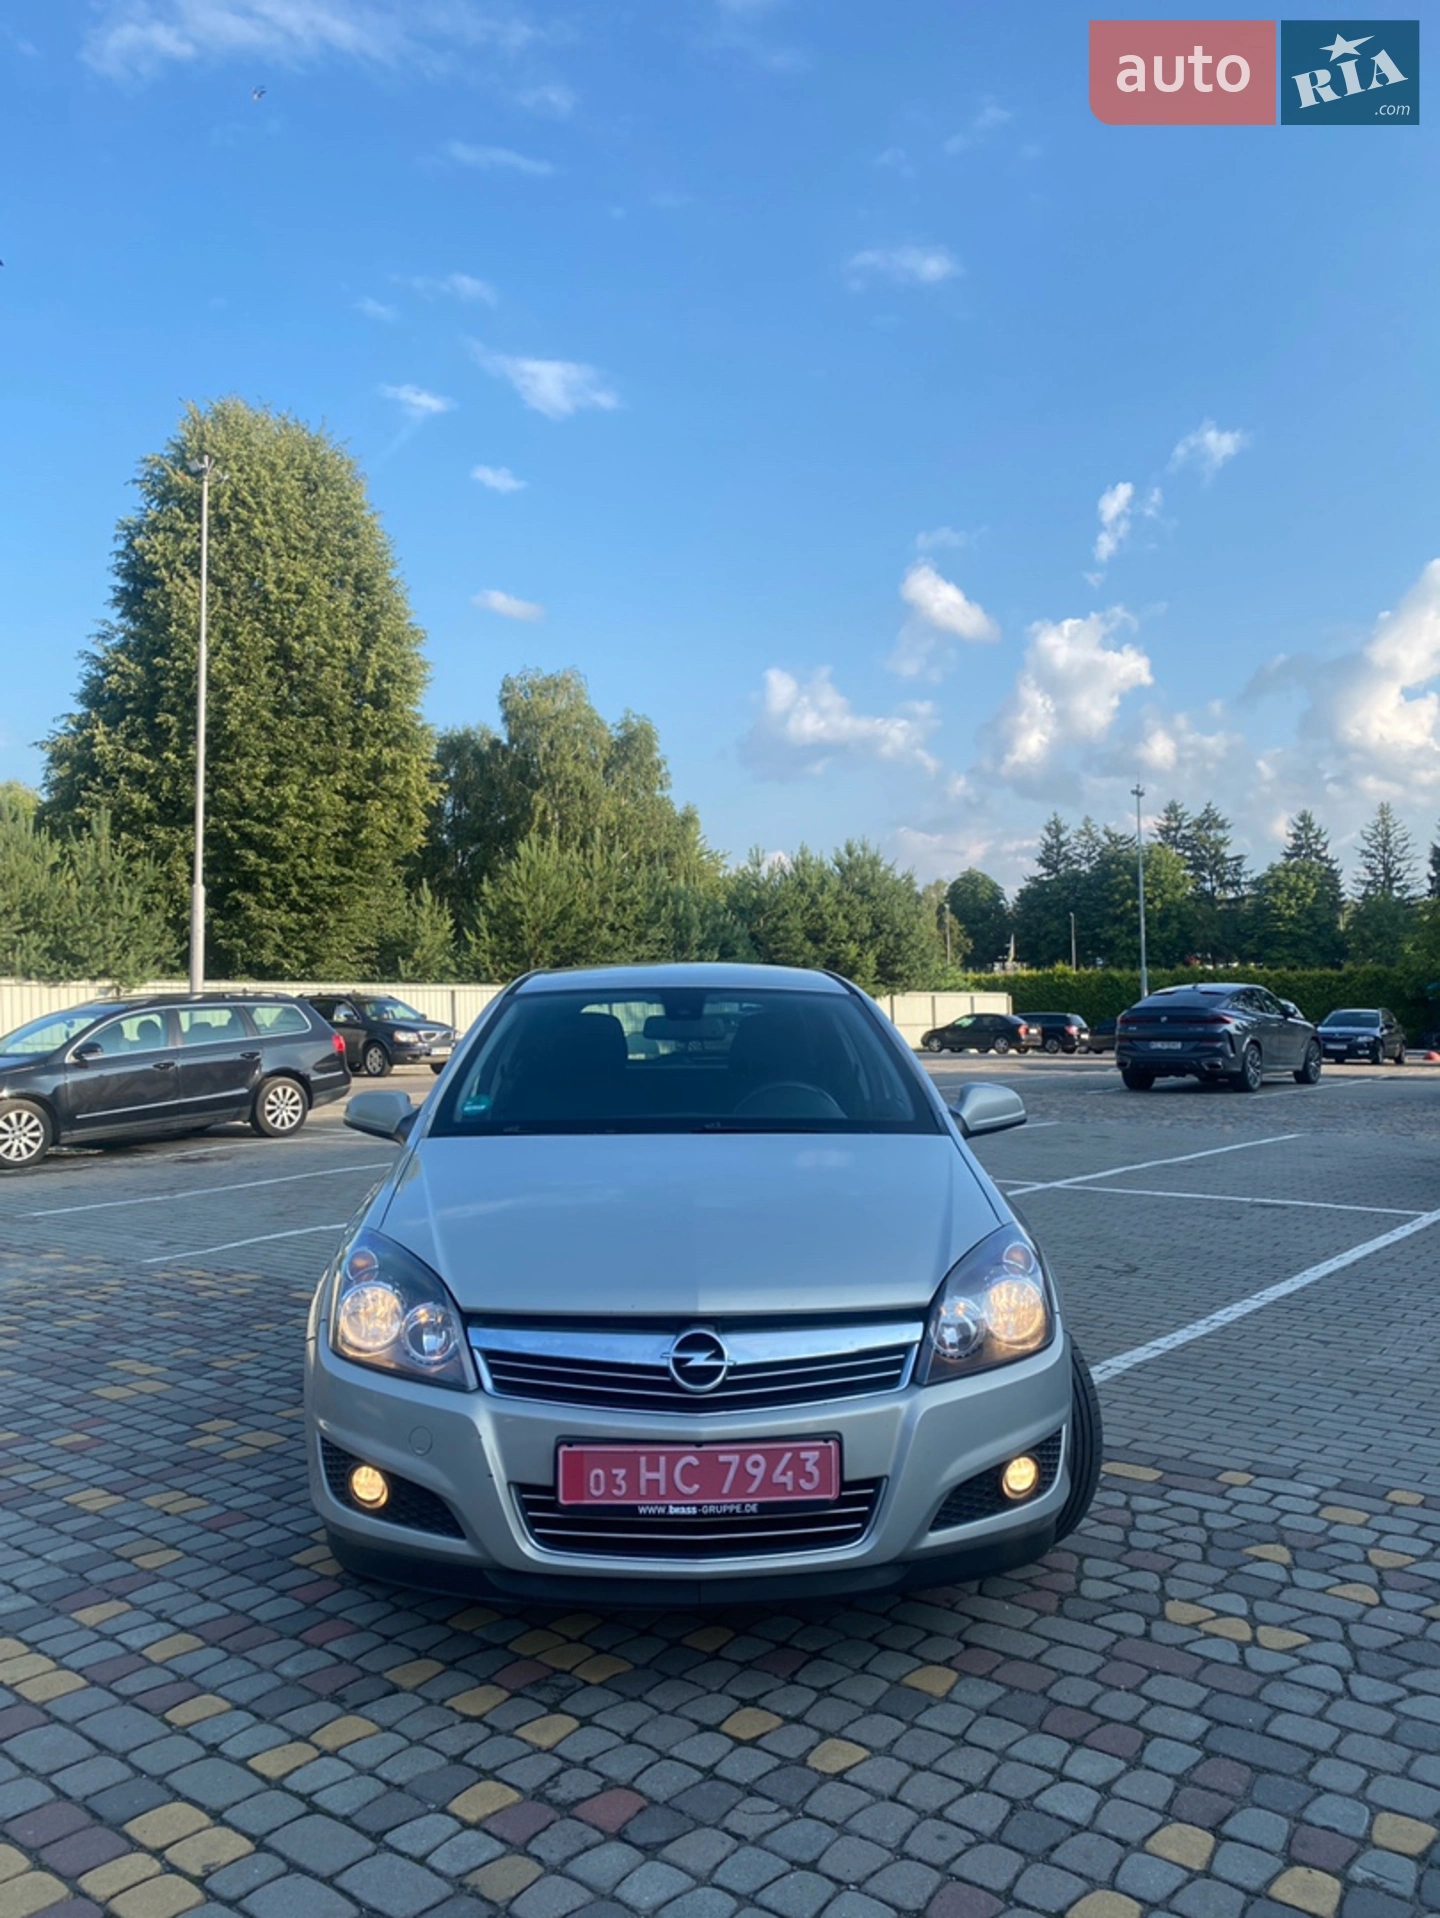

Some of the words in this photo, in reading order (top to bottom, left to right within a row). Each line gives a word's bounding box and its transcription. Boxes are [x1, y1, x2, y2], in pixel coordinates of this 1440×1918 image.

[588, 1468, 627, 1497] 03
[639, 1455, 700, 1496] HC
[717, 1451, 820, 1494] 7943
